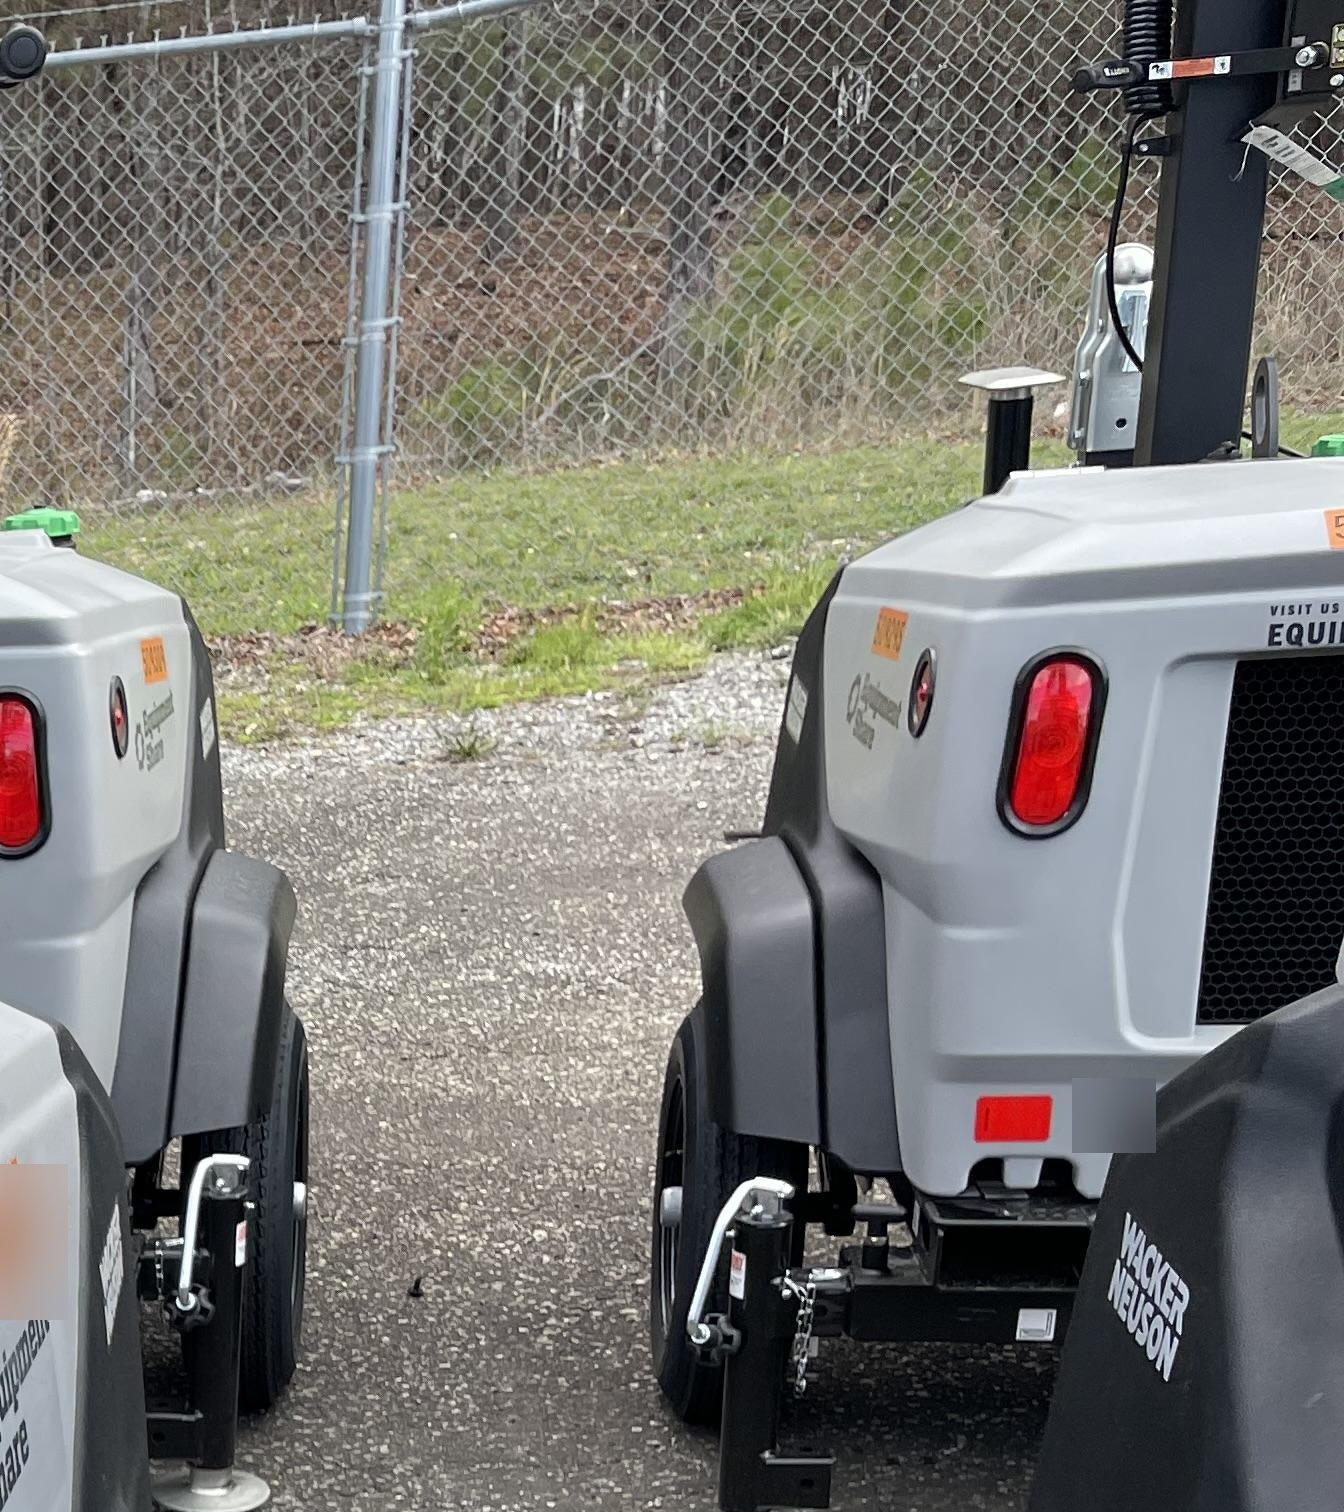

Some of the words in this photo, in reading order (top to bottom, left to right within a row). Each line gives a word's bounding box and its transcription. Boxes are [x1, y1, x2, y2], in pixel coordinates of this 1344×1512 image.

[1267, 620, 1344, 648] EQUI
[1270, 603, 1313, 616] VISIT
[1320, 602, 1340, 614] US
[1120, 1211, 1190, 1336] WACKER
[1107, 1258, 1180, 1382] NEUSON
